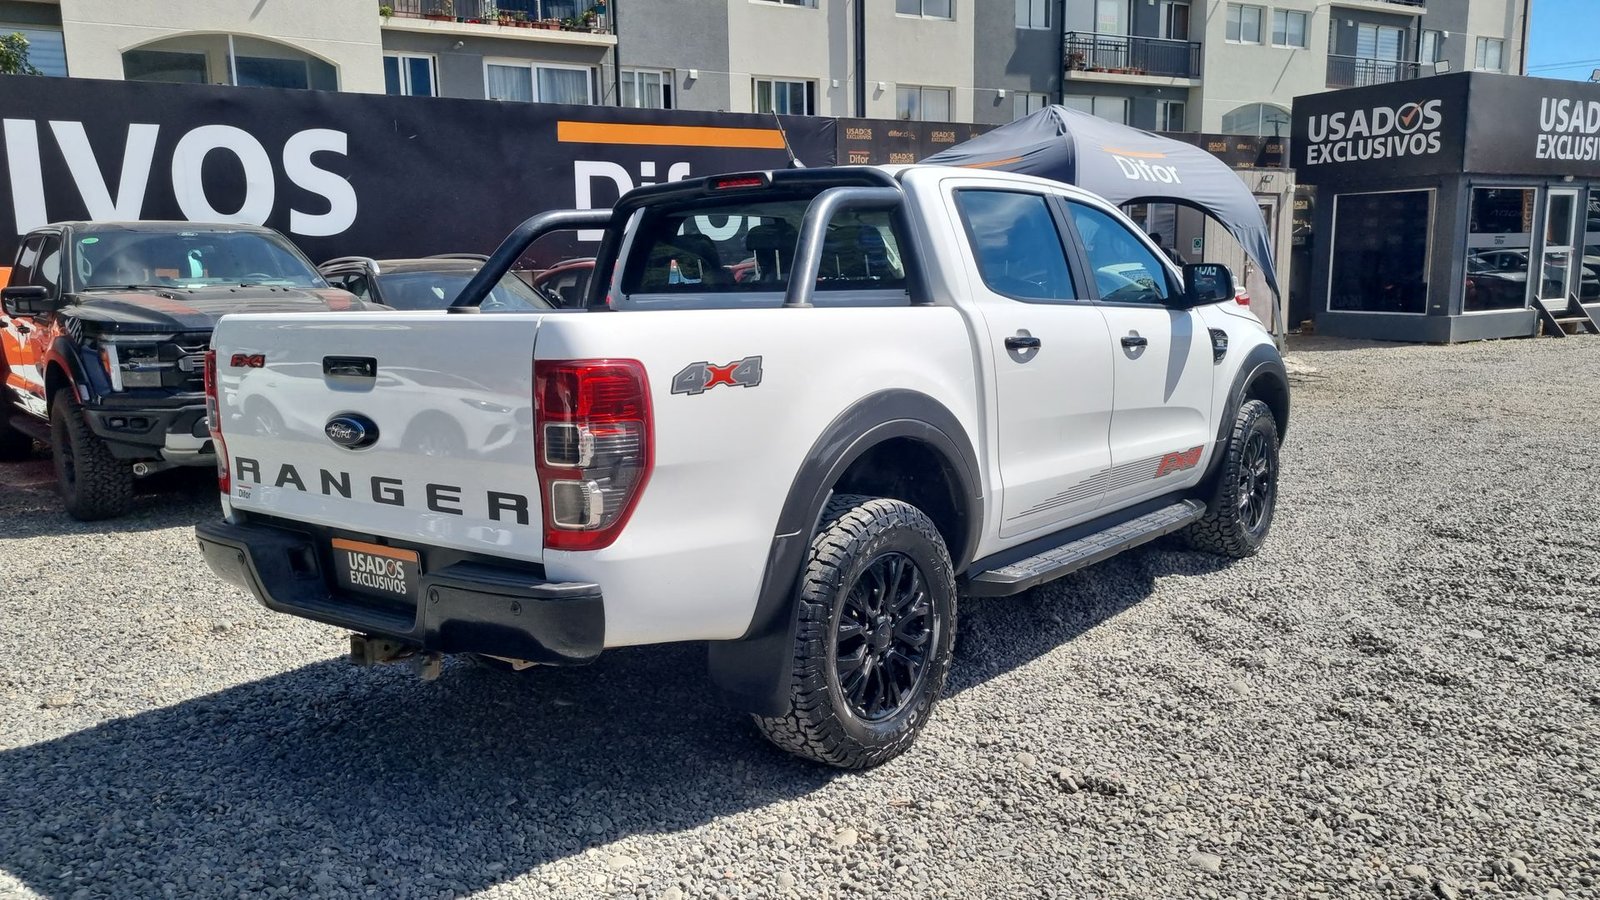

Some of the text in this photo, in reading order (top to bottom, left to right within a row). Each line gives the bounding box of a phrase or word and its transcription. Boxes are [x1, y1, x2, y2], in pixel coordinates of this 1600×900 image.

[846, 127, 871, 135] USADOS
[931, 130, 955, 138] USADOS
[1307, 99, 1442, 143] USADOS
[849, 155, 869, 164] Difor
[1306, 131, 1441, 165] EXCLUSIVOS
[1535, 134, 1600, 160] EXCLUSI
[3, 117, 358, 237] IVOS
[1112, 154, 1182, 184] Difor
[235, 456, 530, 525] RANGER
[348, 552, 405, 580] USADOS
[350, 570, 407, 595] EXCLUSIVOS
